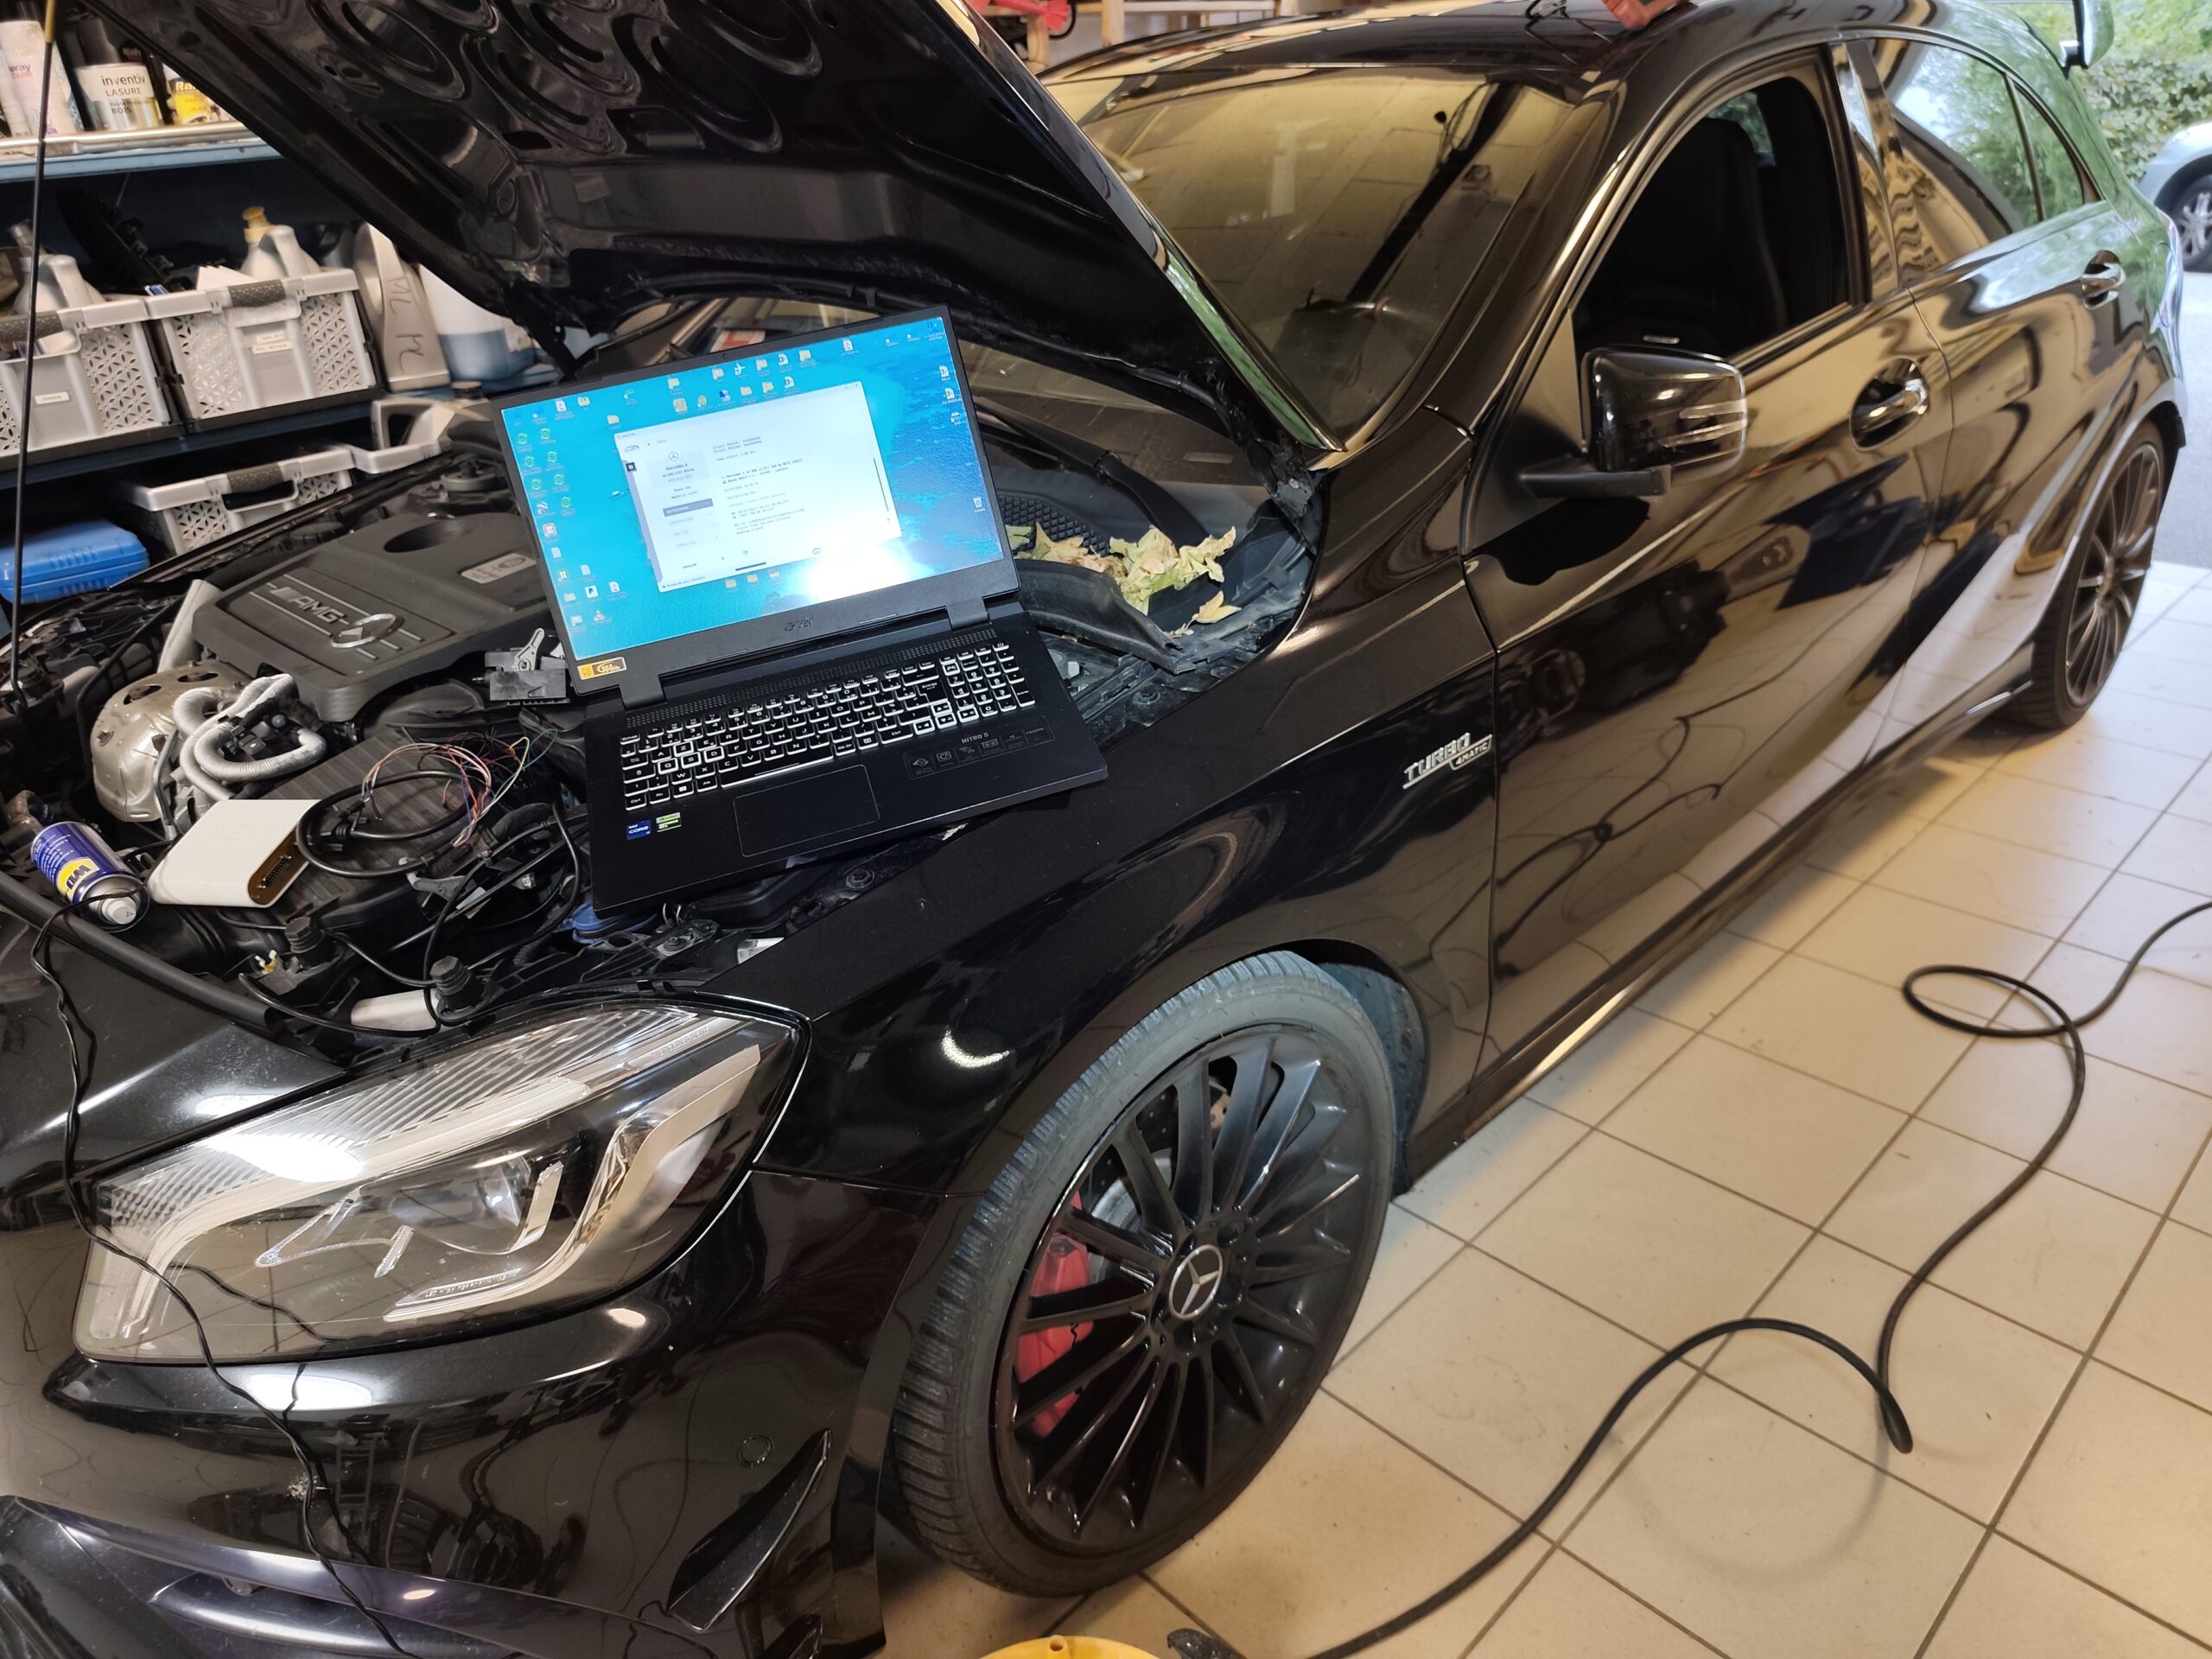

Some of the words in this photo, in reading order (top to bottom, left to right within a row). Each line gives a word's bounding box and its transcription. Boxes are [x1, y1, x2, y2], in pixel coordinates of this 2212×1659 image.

[101, 74, 145, 86] inventiv
[105, 87, 142, 97] LASURE
[288, 596, 345, 622] AMG
[961, 734, 982, 744] NITRO
[1404, 733, 1471, 782] TURBO
[1456, 742, 1488, 765] 4MATIC
